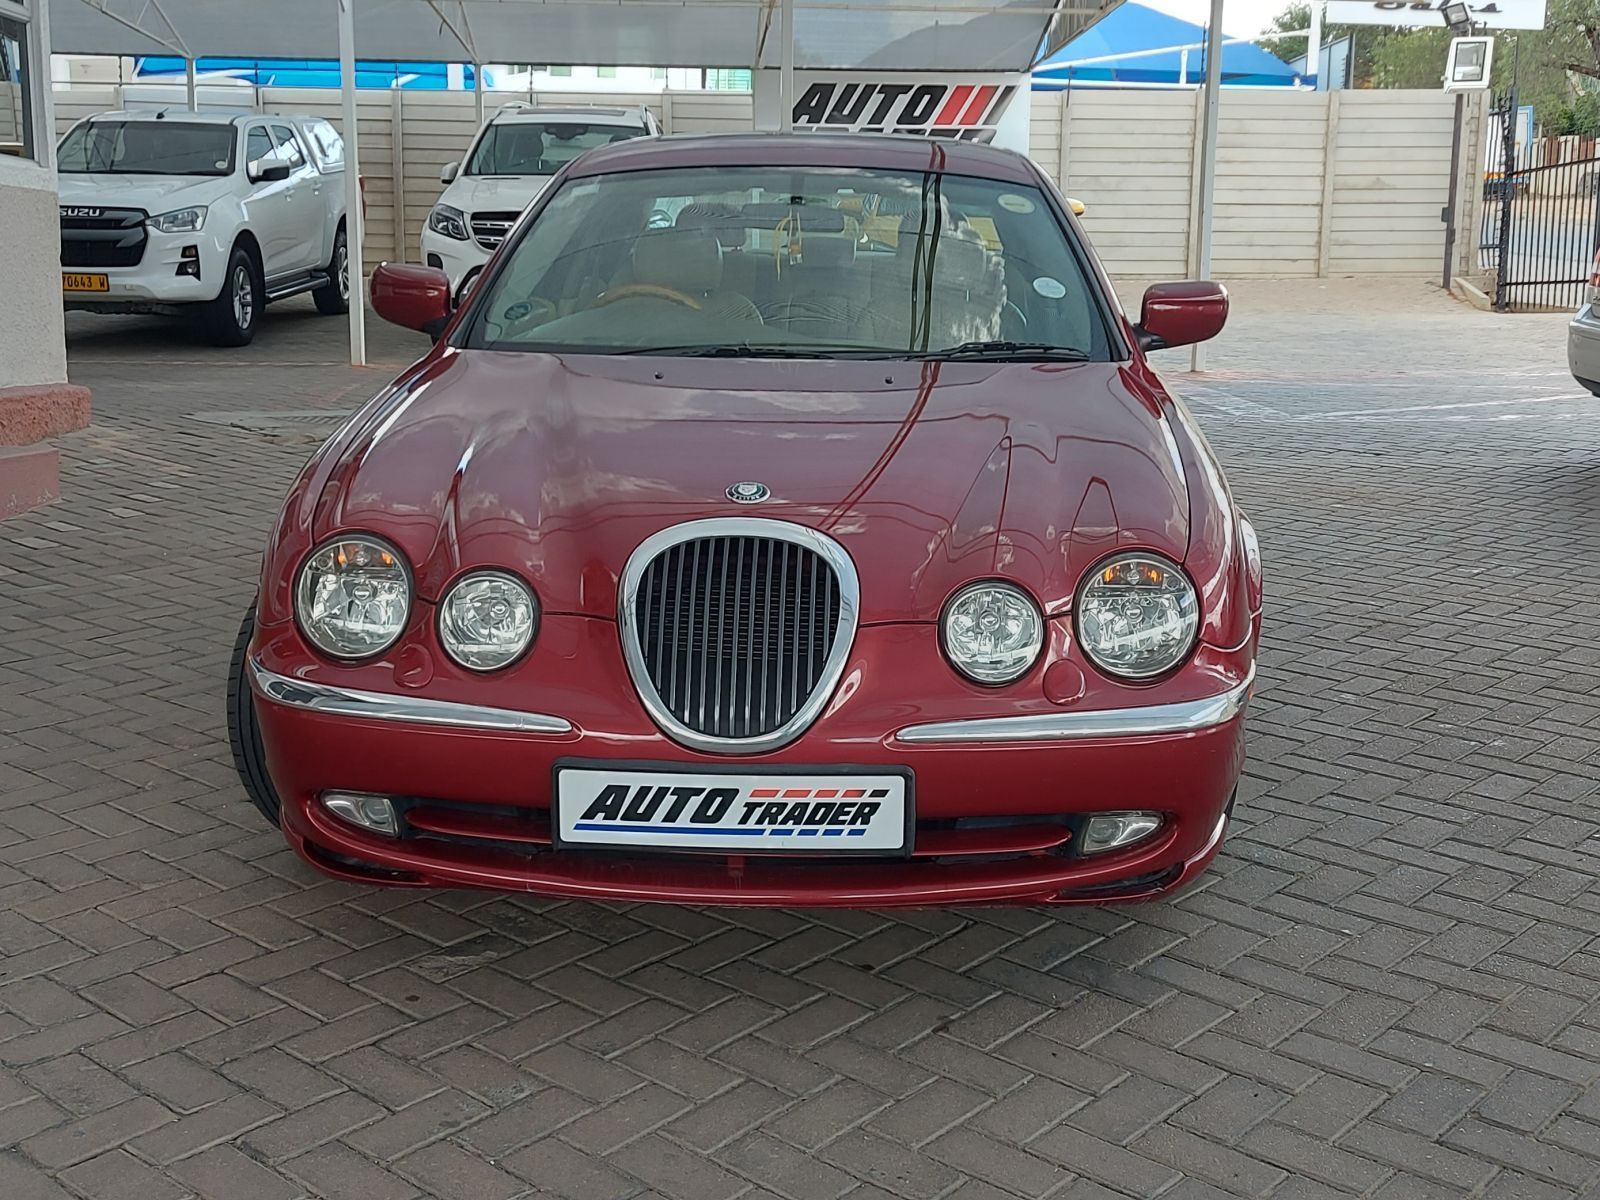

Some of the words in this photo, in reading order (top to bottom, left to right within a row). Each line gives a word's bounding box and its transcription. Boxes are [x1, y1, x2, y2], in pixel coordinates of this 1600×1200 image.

[792, 83, 949, 125] AUTO
[579, 784, 740, 824] AUTO
[737, 802, 881, 826] TRADER
